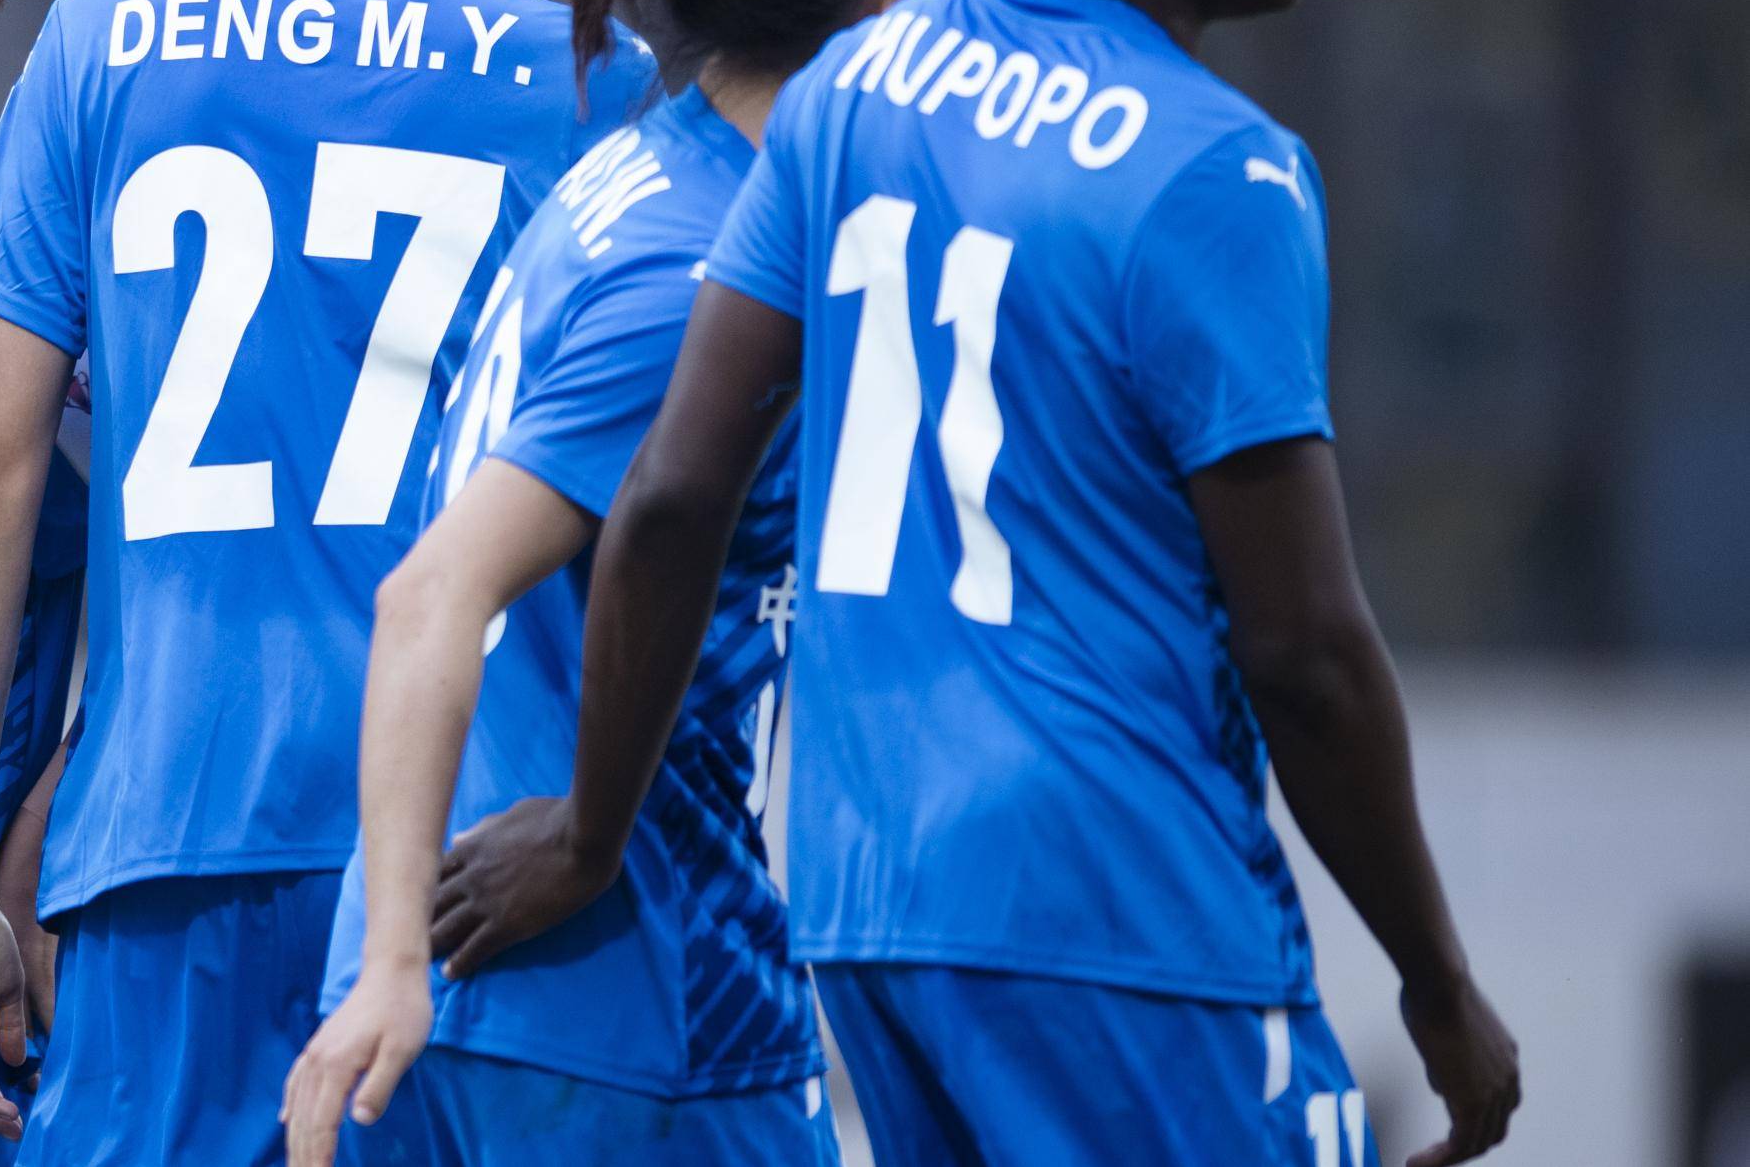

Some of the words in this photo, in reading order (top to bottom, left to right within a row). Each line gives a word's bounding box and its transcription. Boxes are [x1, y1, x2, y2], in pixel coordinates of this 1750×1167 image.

[834, 10, 1148, 170] MUPOPO
[112, 140, 506, 542] 27
[815, 193, 1014, 626] 11
